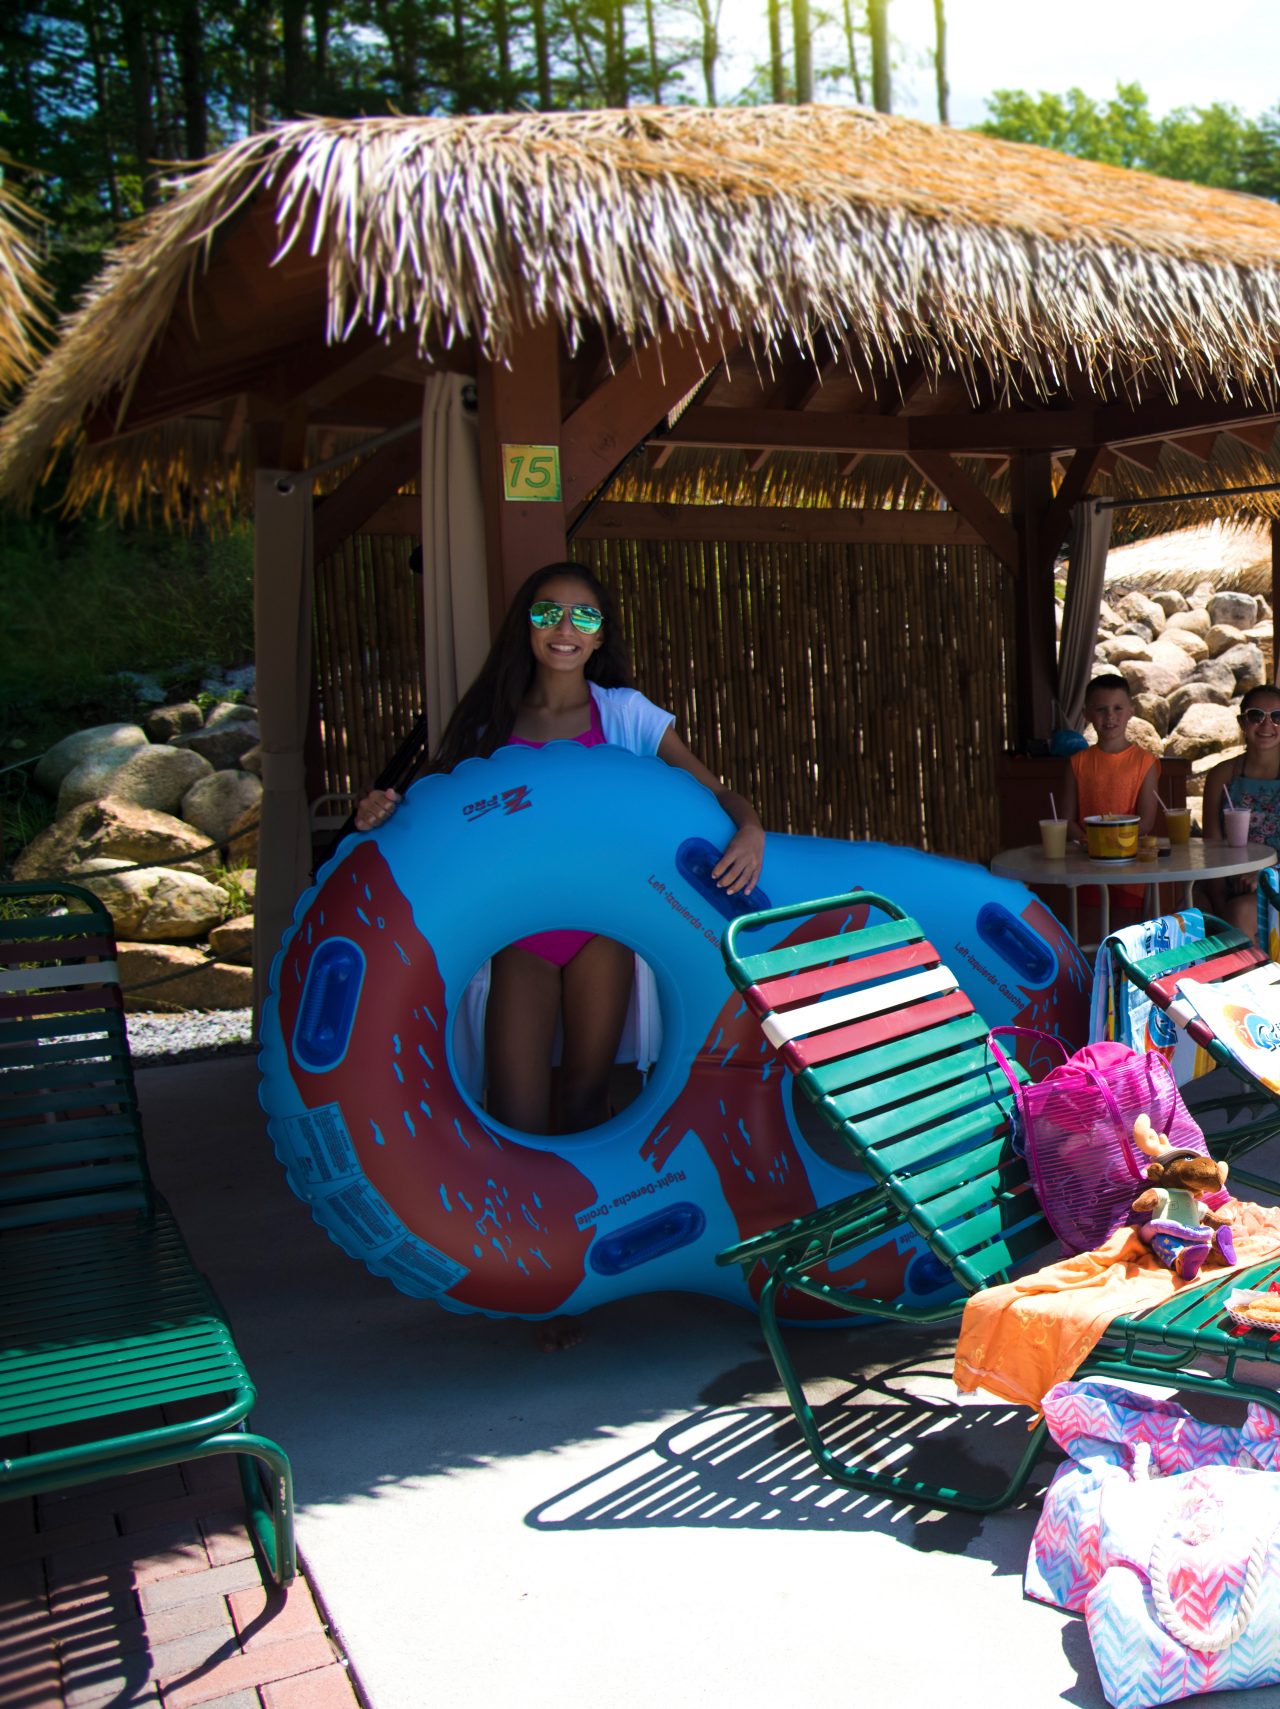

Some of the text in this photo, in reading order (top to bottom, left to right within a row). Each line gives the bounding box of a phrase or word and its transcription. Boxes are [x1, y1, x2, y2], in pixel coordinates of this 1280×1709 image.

[510, 456, 553, 488] 15
[463, 794, 498, 815] PRO
[648, 875, 666, 894] Left
[704, 930, 721, 951] Gau
[578, 1171, 686, 1225] Right Derecha Droite
